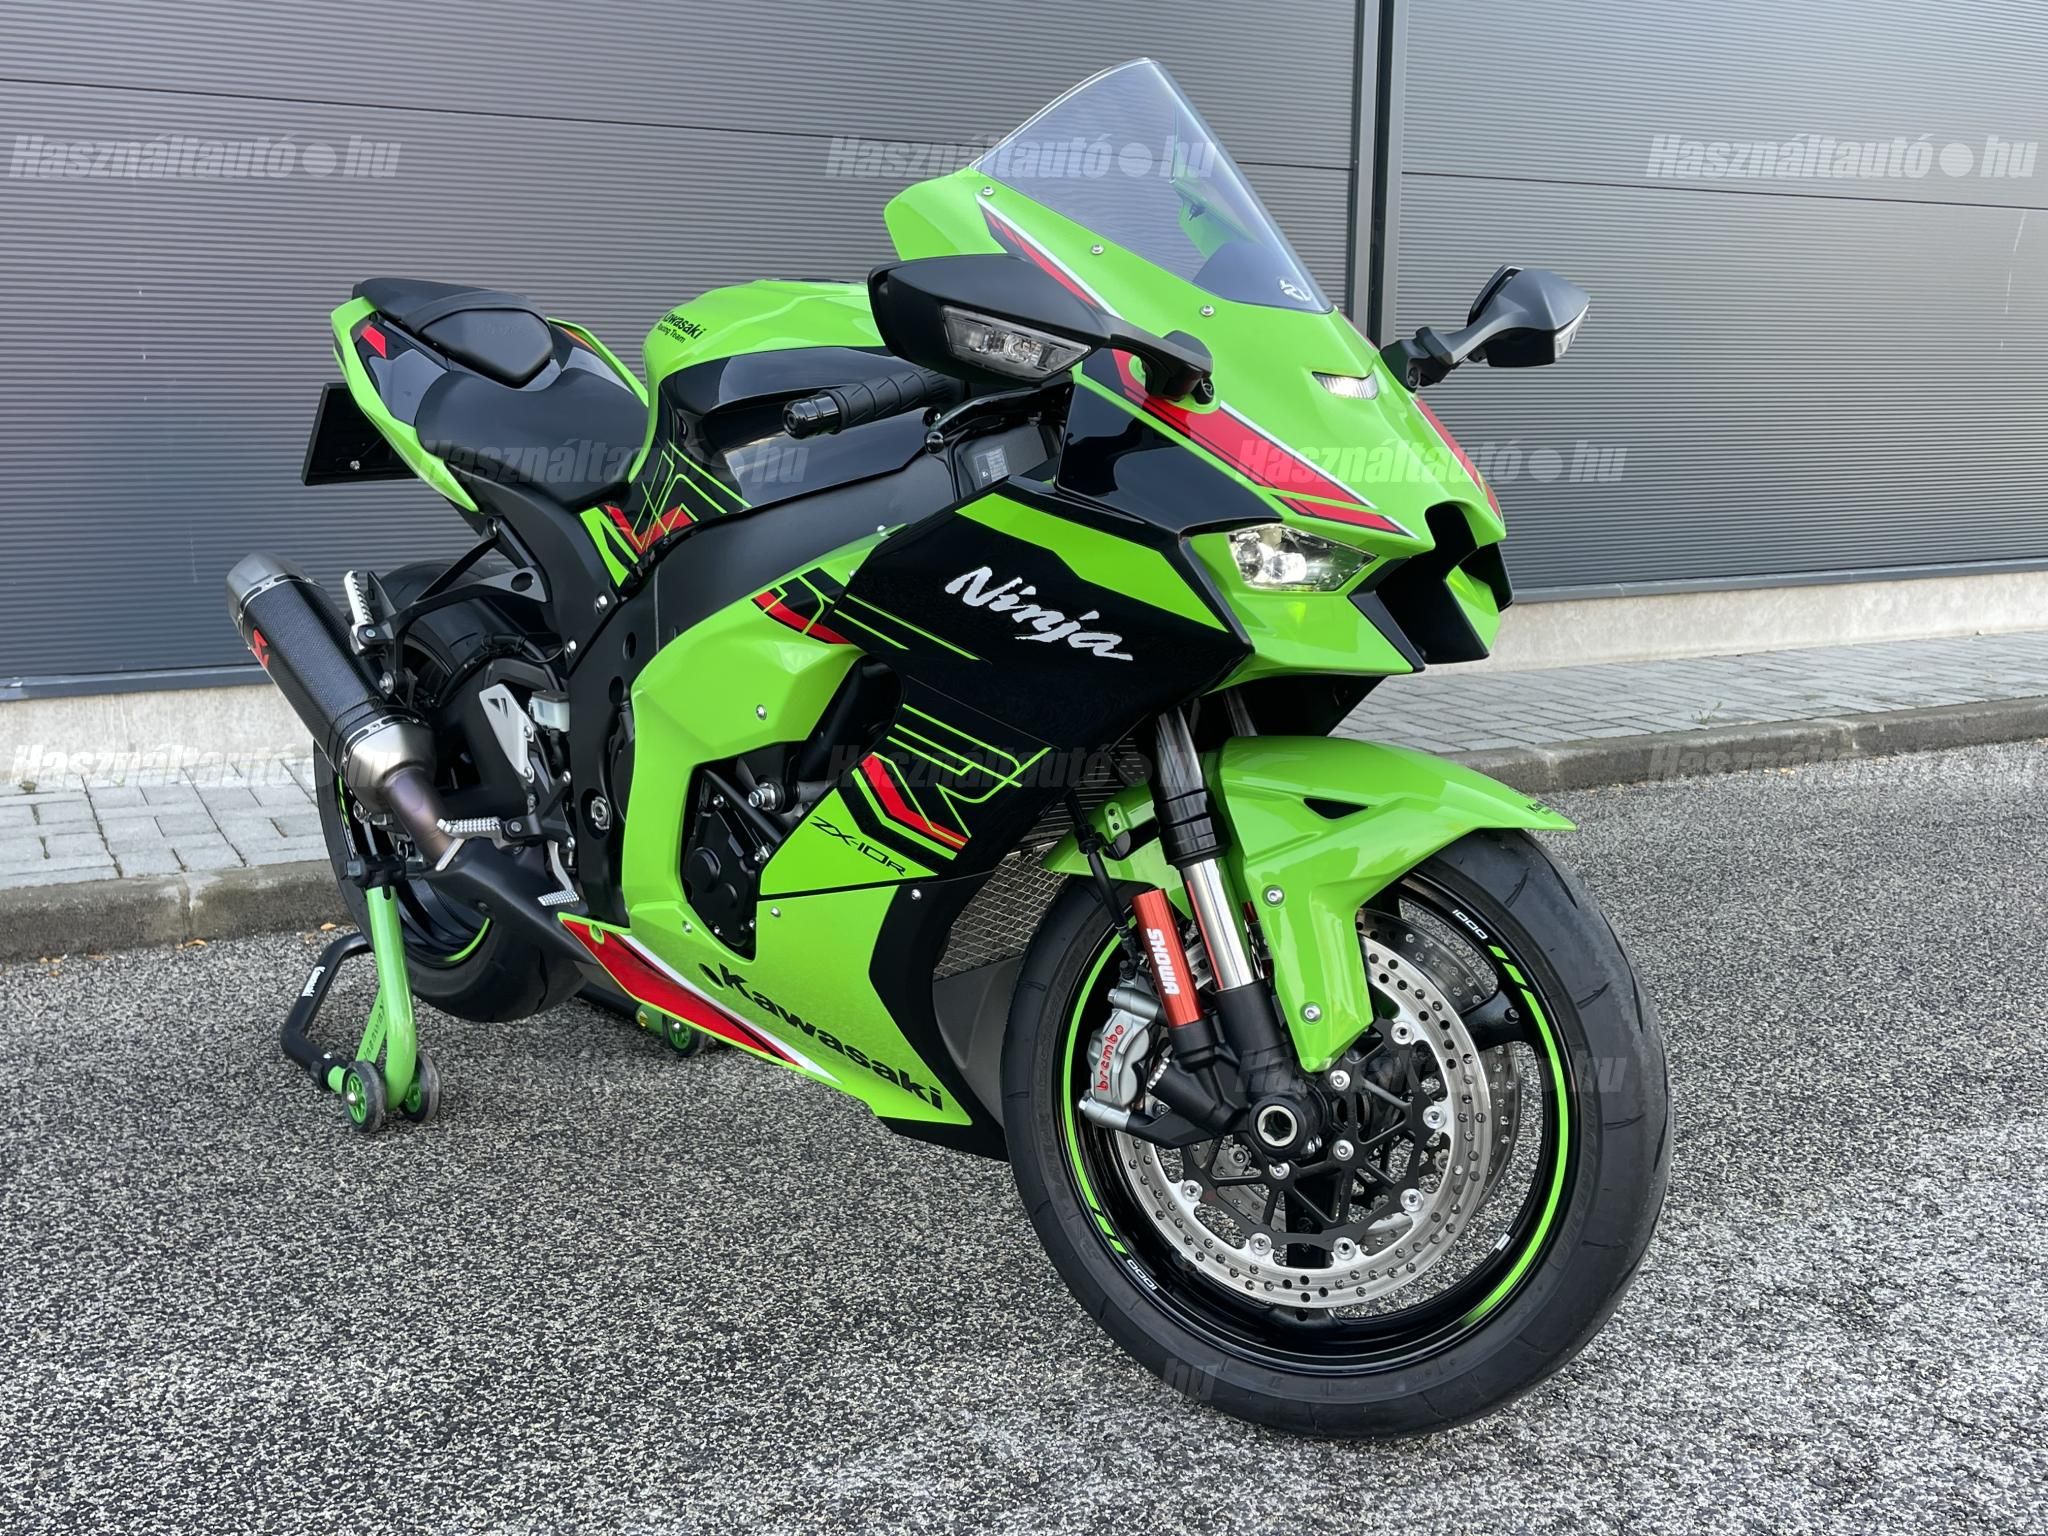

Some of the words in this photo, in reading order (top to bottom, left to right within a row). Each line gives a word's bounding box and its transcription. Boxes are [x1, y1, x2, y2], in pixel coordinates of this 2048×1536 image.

[944, 566, 1134, 661] Ninja
[809, 815, 906, 877] ZX-10R
[1452, 909, 1489, 940] 1000
[1146, 927, 1181, 996] SHOWA
[718, 962, 943, 1111] Kawasaki
[1096, 1024, 1125, 1091] brembo
[1126, 1259, 1158, 1290] 1000
